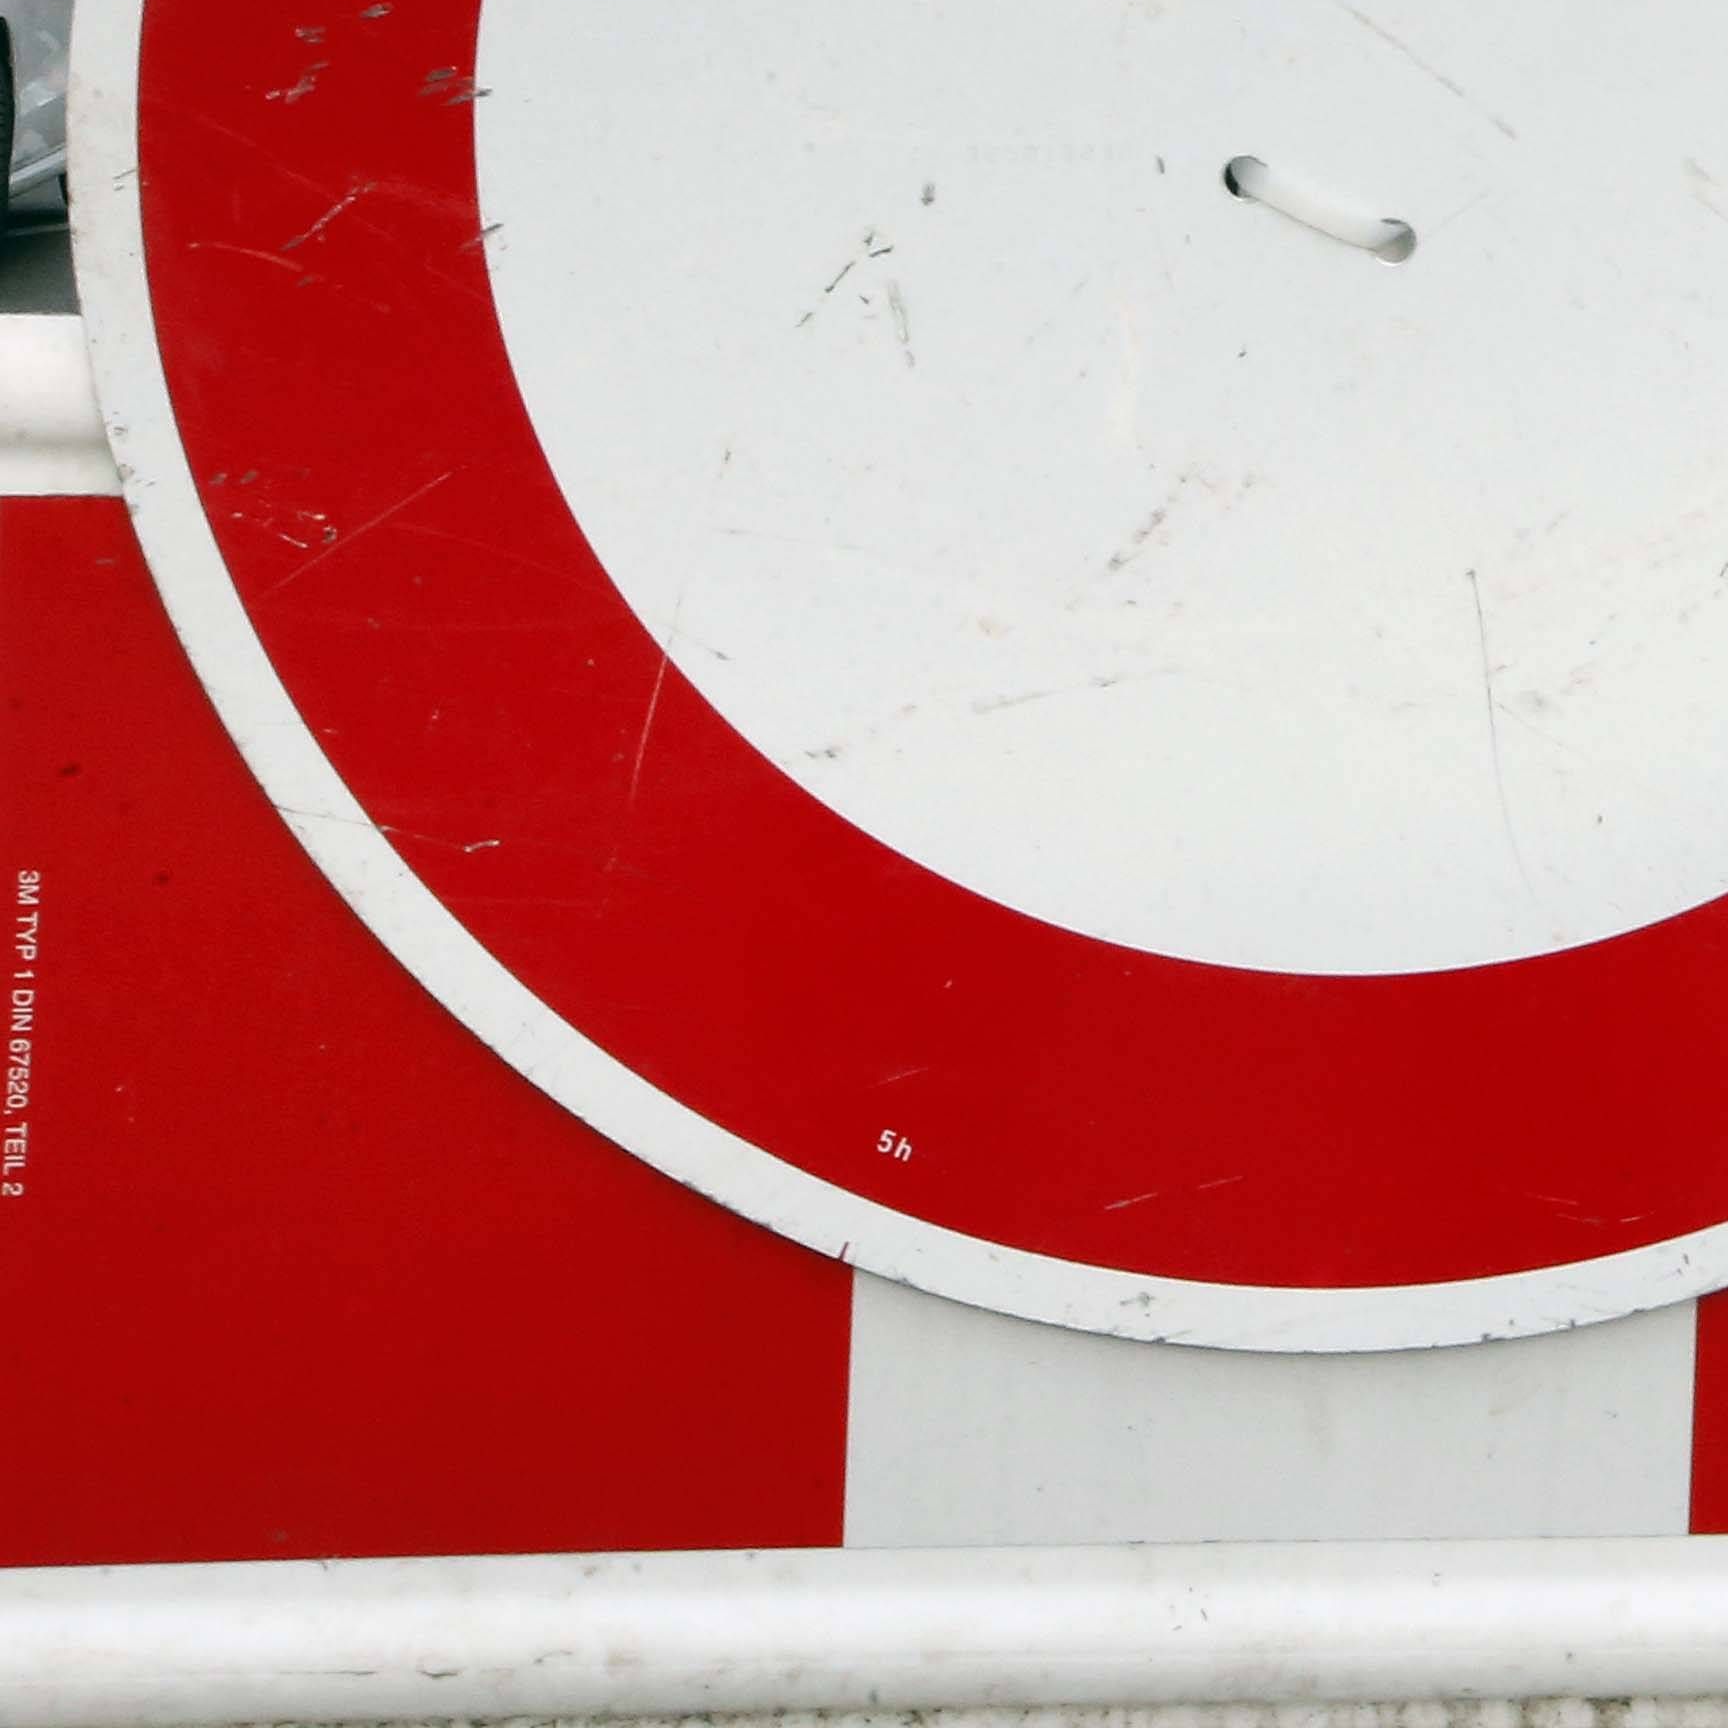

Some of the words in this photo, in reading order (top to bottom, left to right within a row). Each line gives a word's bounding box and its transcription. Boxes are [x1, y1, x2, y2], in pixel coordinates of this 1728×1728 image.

[17, 870, 41, 905] 3M
[15, 912, 39, 961] TYP
[13, 969, 35, 979] 1
[10, 989, 35, 1032] DIN
[3, 1038, 32, 1115] 67520,
[3, 1122, 28, 1176] TEIL
[2, 1182, 25, 1196] 2
